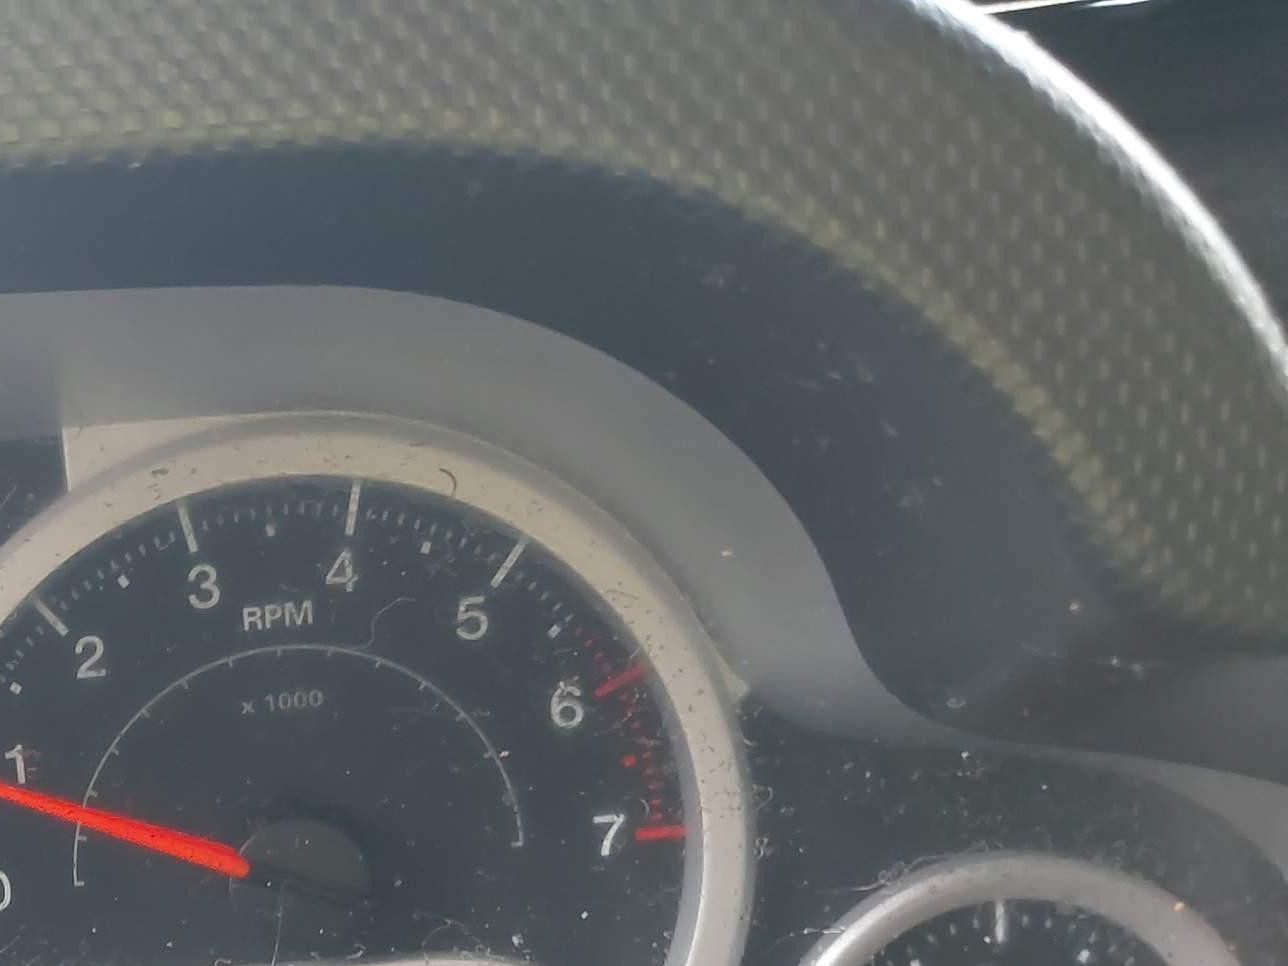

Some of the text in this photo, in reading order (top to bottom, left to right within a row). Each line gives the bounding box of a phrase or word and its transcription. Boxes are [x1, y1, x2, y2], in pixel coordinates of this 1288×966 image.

[187, 564, 221, 609] 3
[325, 549, 360, 592] 4
[242, 599, 313, 631] RPM
[456, 596, 489, 640] 5
[74, 635, 107, 680] 2
[264, 688, 324, 712] 1000
[550, 680, 585, 728] 6
[4, 744, 27, 785] 1
[592, 815, 626, 857] 7
